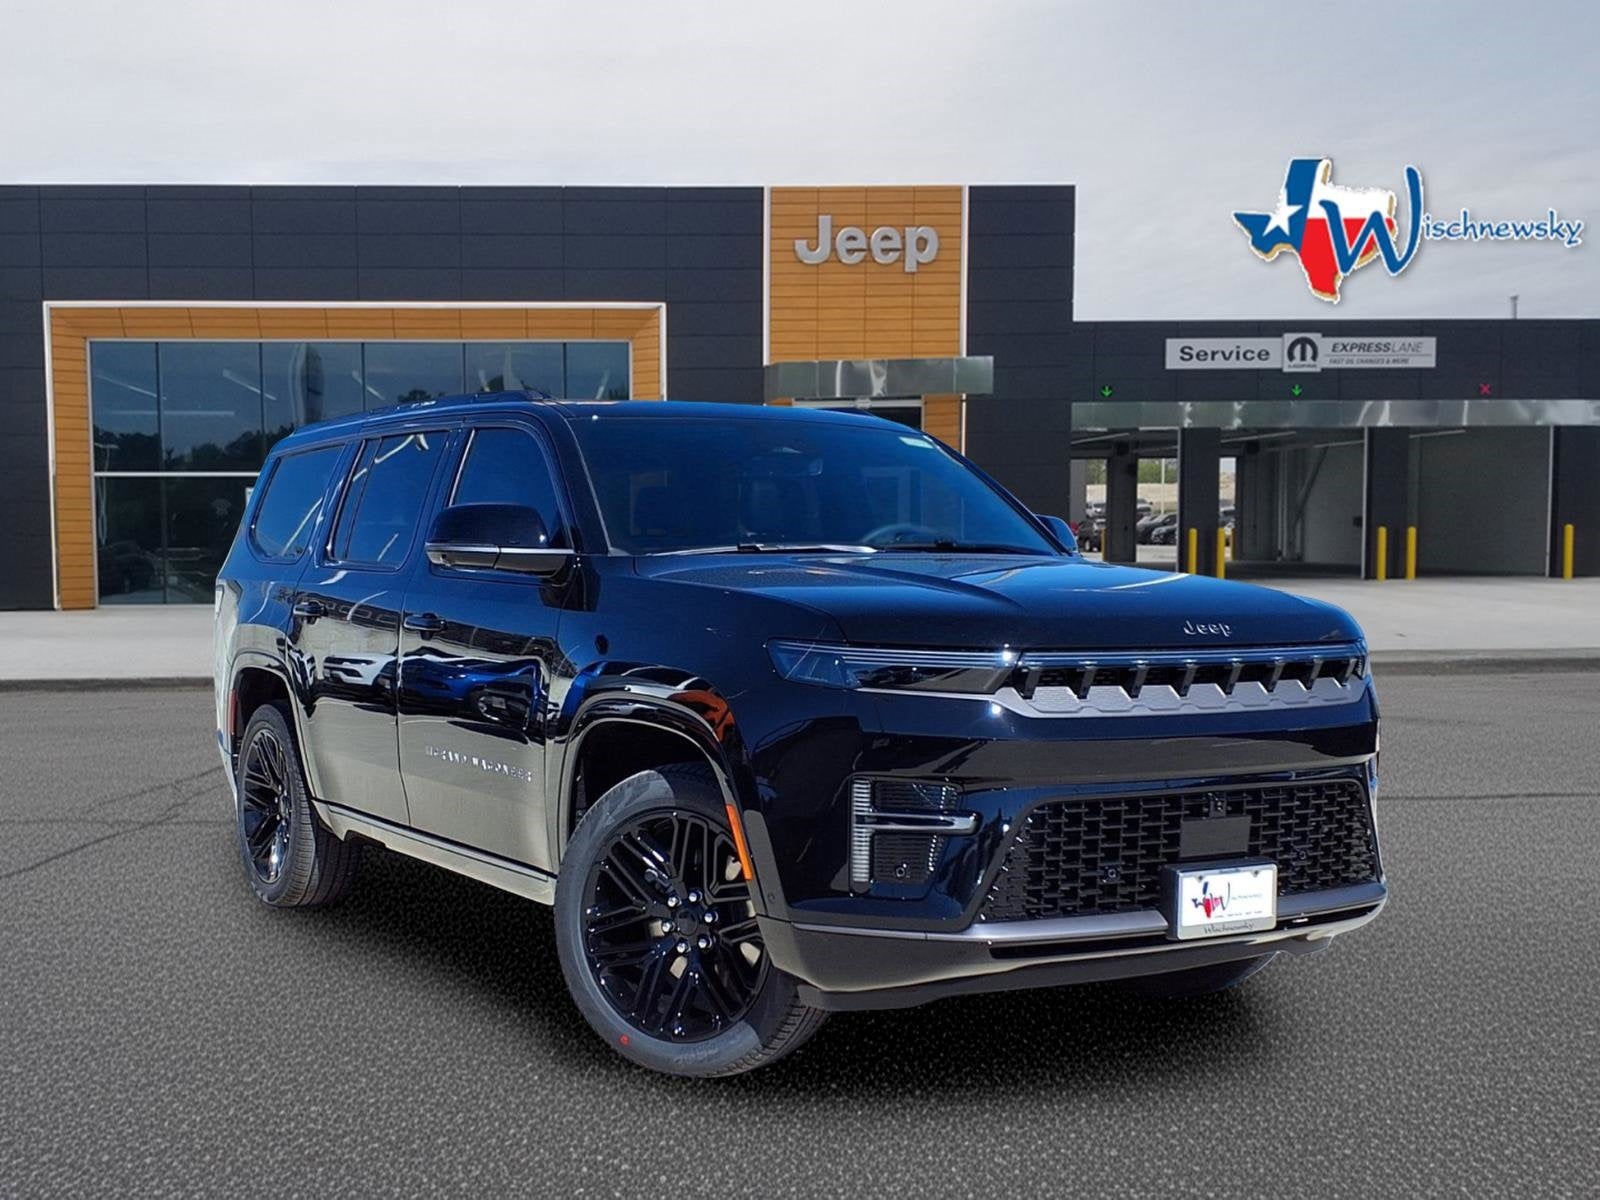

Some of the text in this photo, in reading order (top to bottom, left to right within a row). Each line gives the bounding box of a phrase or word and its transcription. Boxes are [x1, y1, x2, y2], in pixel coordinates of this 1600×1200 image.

[794, 214, 940, 273] Jeep
[1179, 345, 1271, 362] Service
[1183, 619, 1233, 637] Jeep
